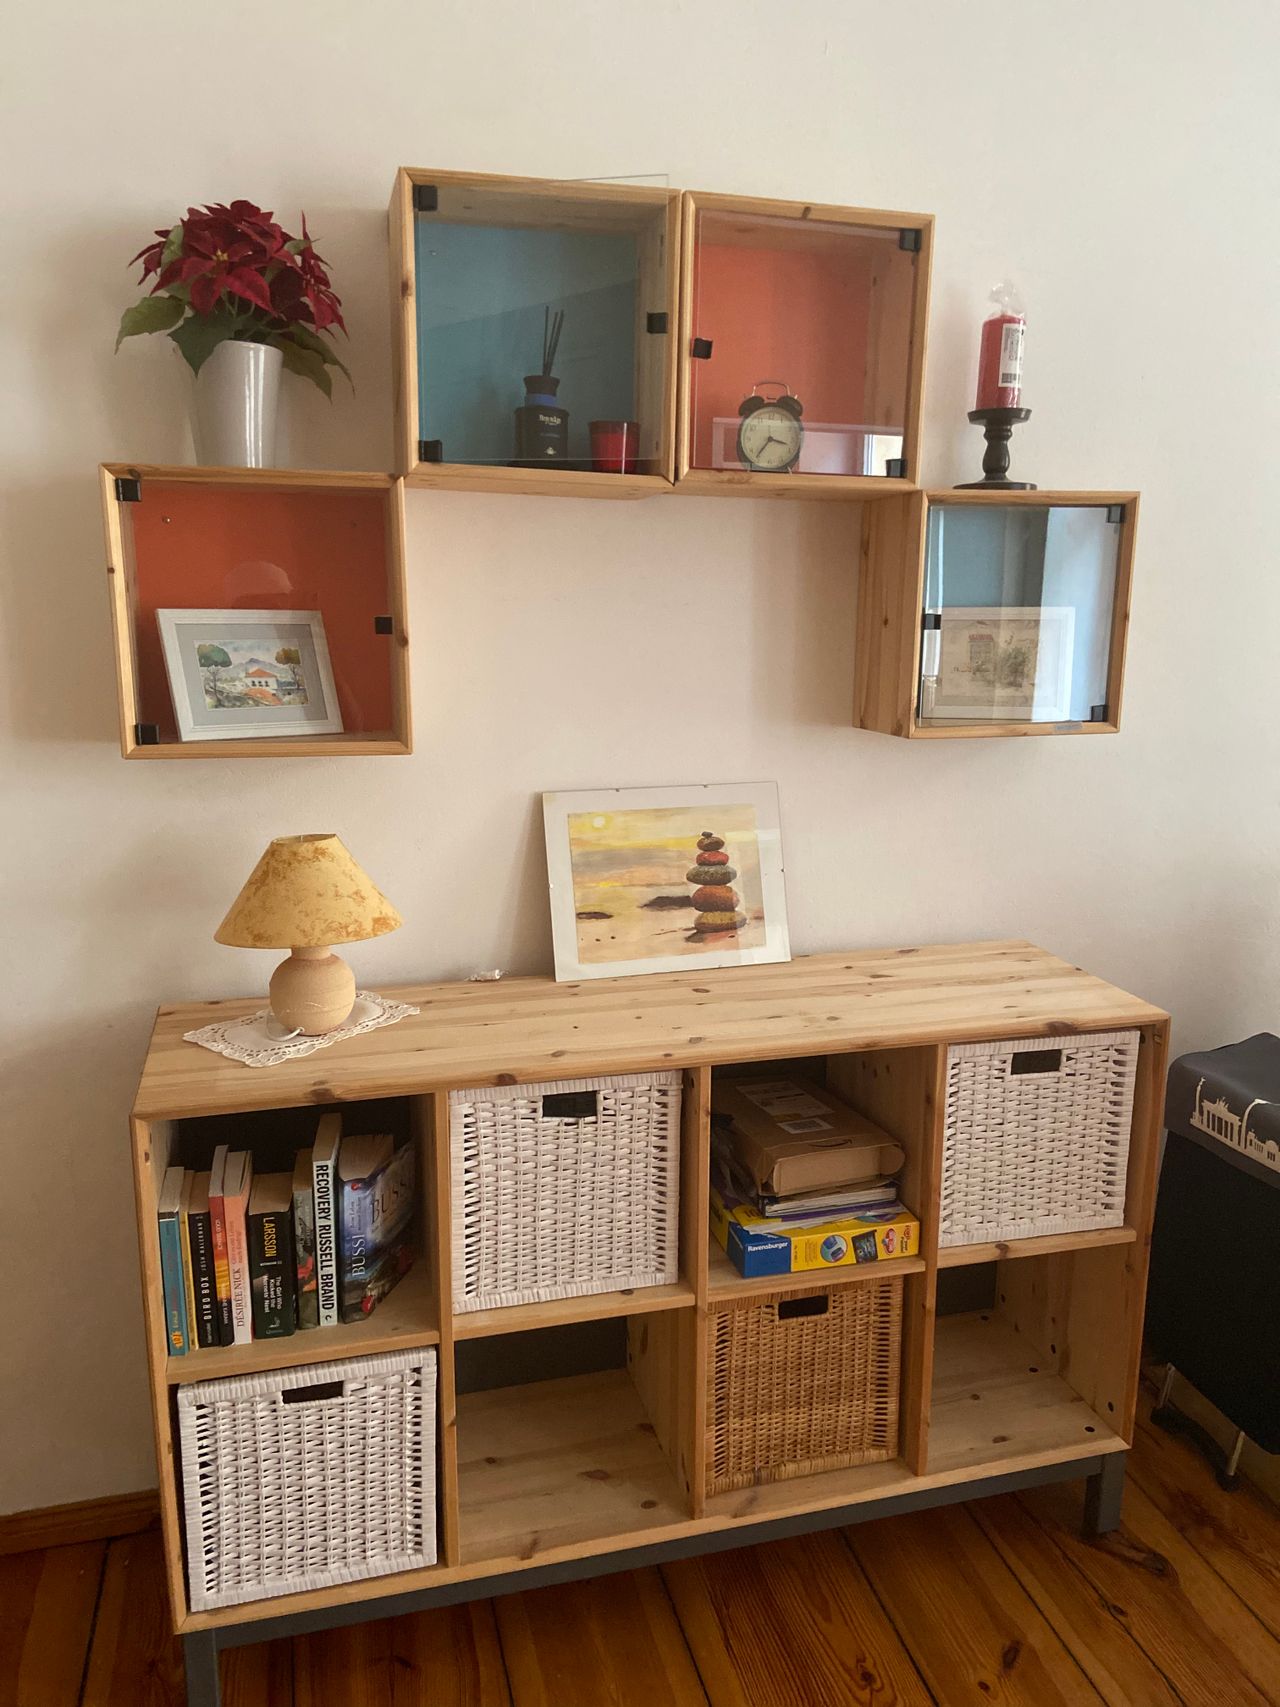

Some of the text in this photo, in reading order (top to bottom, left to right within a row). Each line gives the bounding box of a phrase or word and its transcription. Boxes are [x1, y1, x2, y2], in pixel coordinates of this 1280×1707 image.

[263, 1216, 277, 1258] LARSSON
[315, 1164, 335, 1311] RECOVERY RUSSELL BRAND
[747, 1241, 789, 1252] Ravensburger
[352, 1235, 366, 1276] BUSSI
[200, 1276, 210, 1294] BOX
[232, 1267, 242, 1290] NICK
[202, 1297, 212, 1320] BIRD
[234, 1290, 245, 1328] DÉSIRÉE
